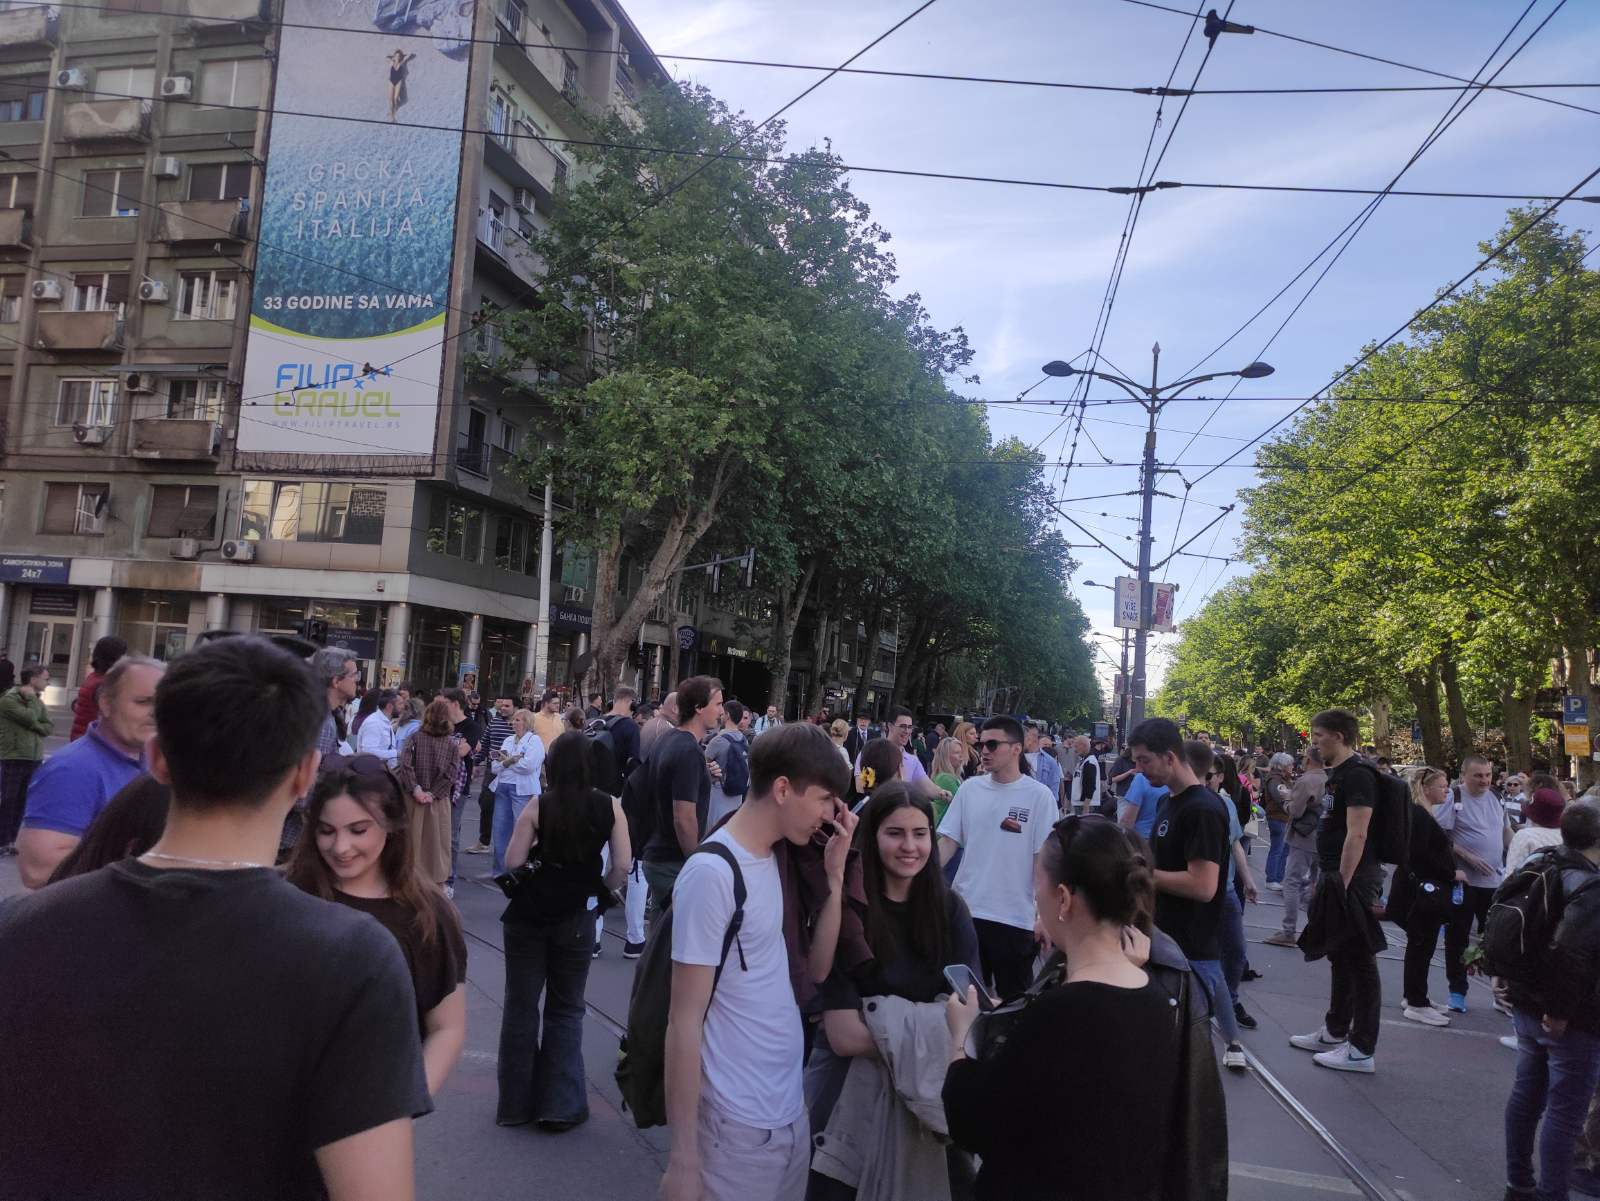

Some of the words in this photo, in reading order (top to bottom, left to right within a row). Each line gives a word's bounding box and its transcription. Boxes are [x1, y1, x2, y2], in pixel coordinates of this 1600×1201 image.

[298, 217, 414, 239] ITALIJA
[263, 297, 282, 310] 33
[286, 295, 353, 310] GODINE
[358, 296, 380, 309] SA
[384, 294, 434, 309] VAMA
[275, 363, 354, 389] FILIP
[1570, 698, 1582, 712] P
